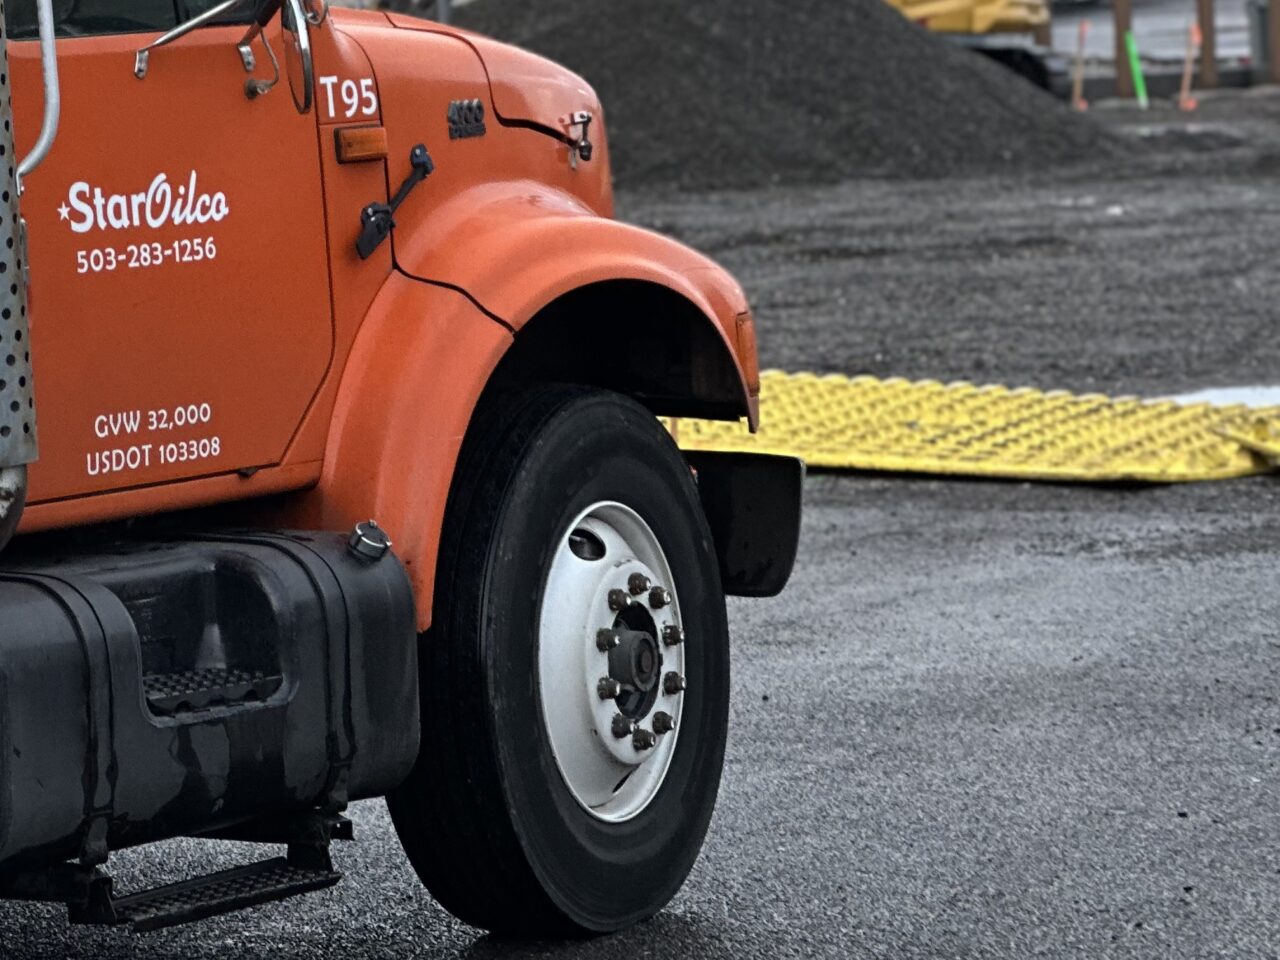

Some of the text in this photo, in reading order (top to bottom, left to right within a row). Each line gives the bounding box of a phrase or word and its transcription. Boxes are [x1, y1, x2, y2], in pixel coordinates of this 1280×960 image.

[319, 75, 378, 119] T95
[76, 236, 217, 274] 503-283-1256
[94, 402, 212, 438] GVW 32,000
[86, 436, 221, 476] USDOT 103308
